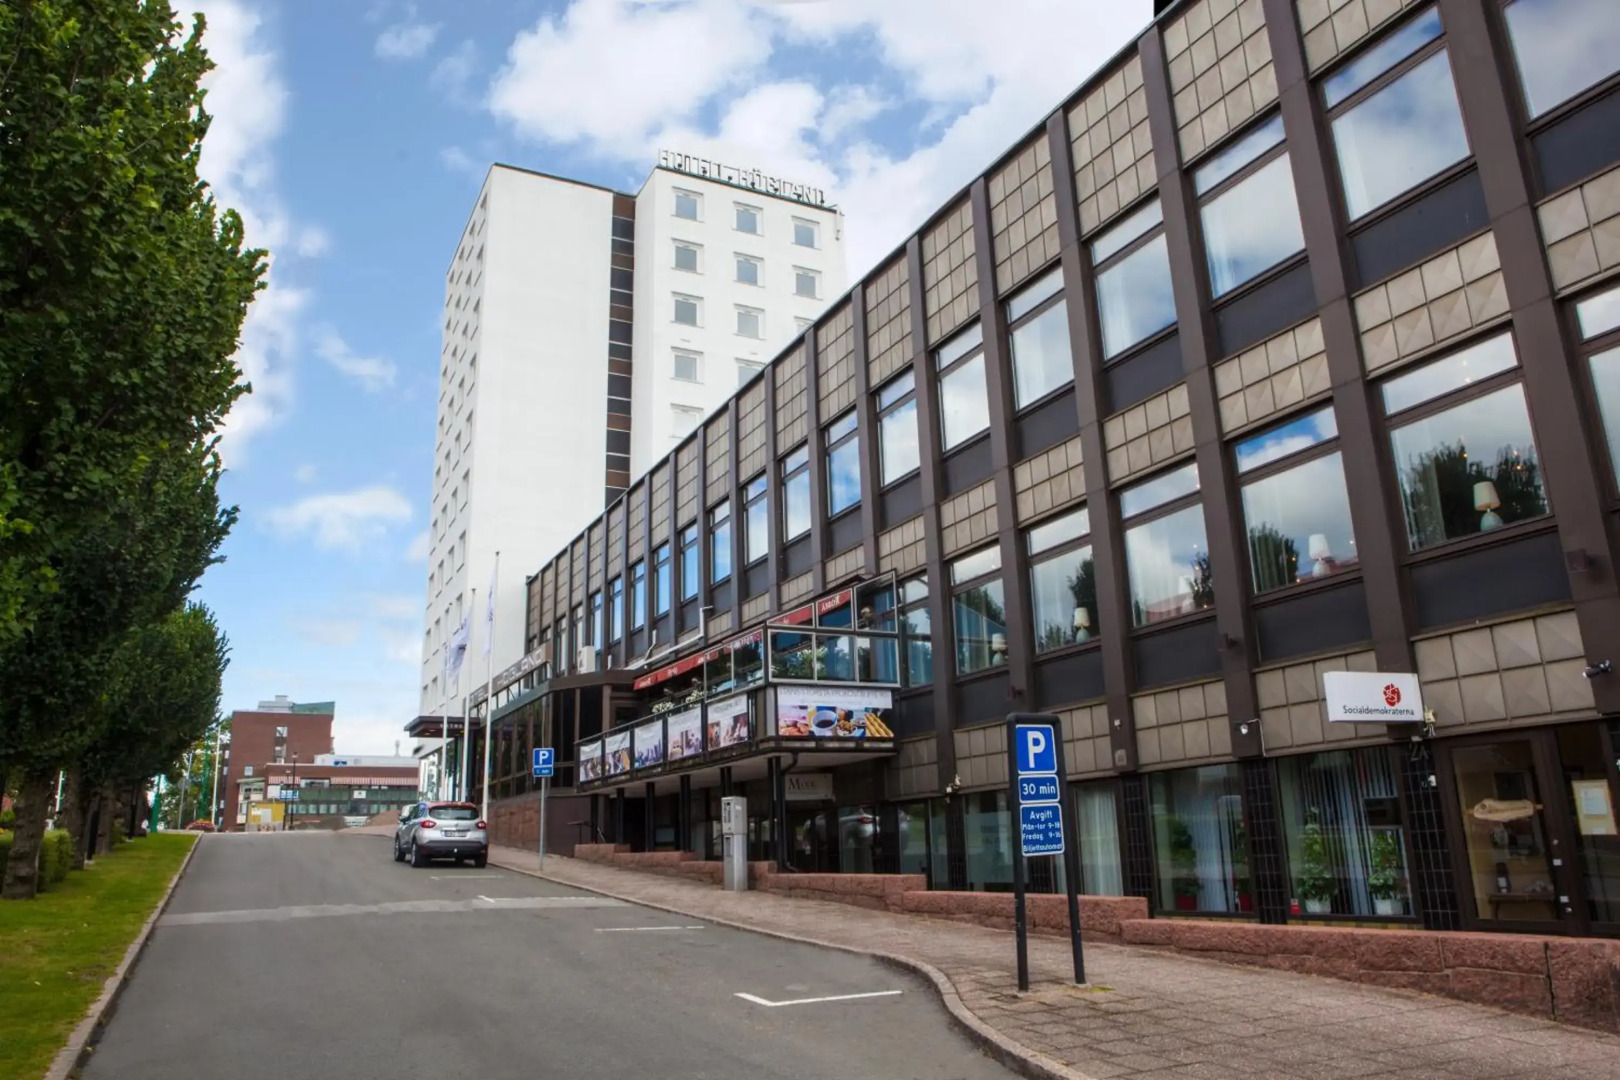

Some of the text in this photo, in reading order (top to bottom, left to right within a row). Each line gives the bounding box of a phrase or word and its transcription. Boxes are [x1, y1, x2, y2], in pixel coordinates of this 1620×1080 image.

[1343, 704, 1415, 716] Socialdemokraterna
[1027, 730, 1046, 768] P
[539, 750, 549, 765] P
[1022, 782, 1057, 795] 30 min
[1029, 809, 1053, 821] Avgift
[1022, 833, 1044, 841] Fredag
